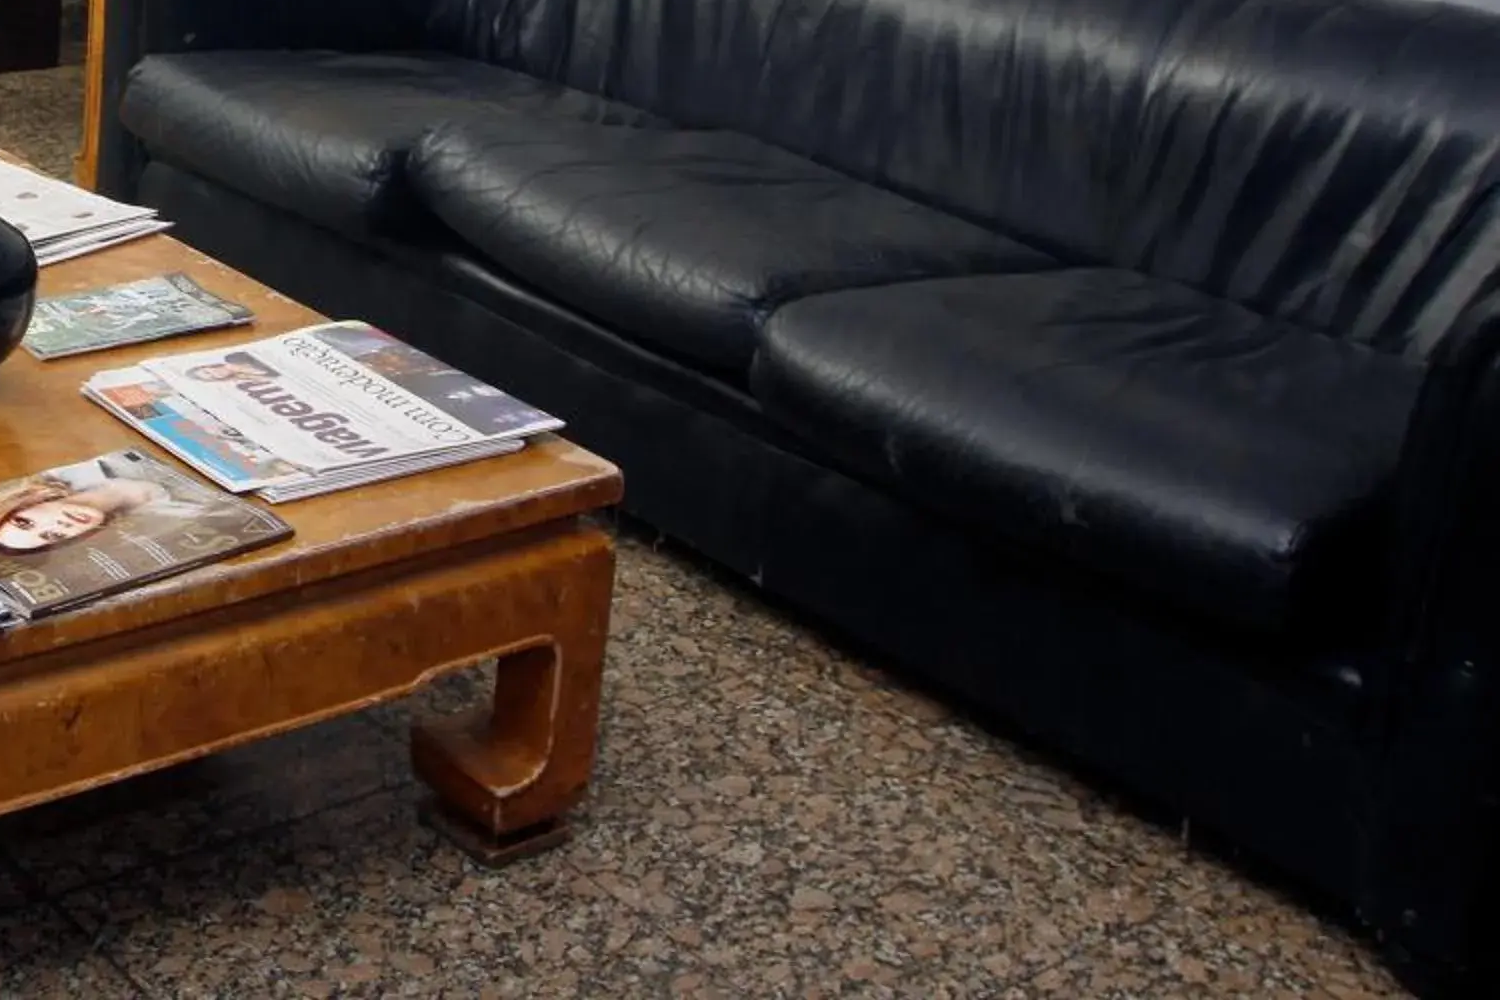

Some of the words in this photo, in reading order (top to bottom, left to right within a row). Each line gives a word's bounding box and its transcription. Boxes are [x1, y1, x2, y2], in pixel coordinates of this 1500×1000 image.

[283, 337, 408, 409] moderação
[236, 380, 389, 458] viagem
[403, 406, 470, 442] Com
